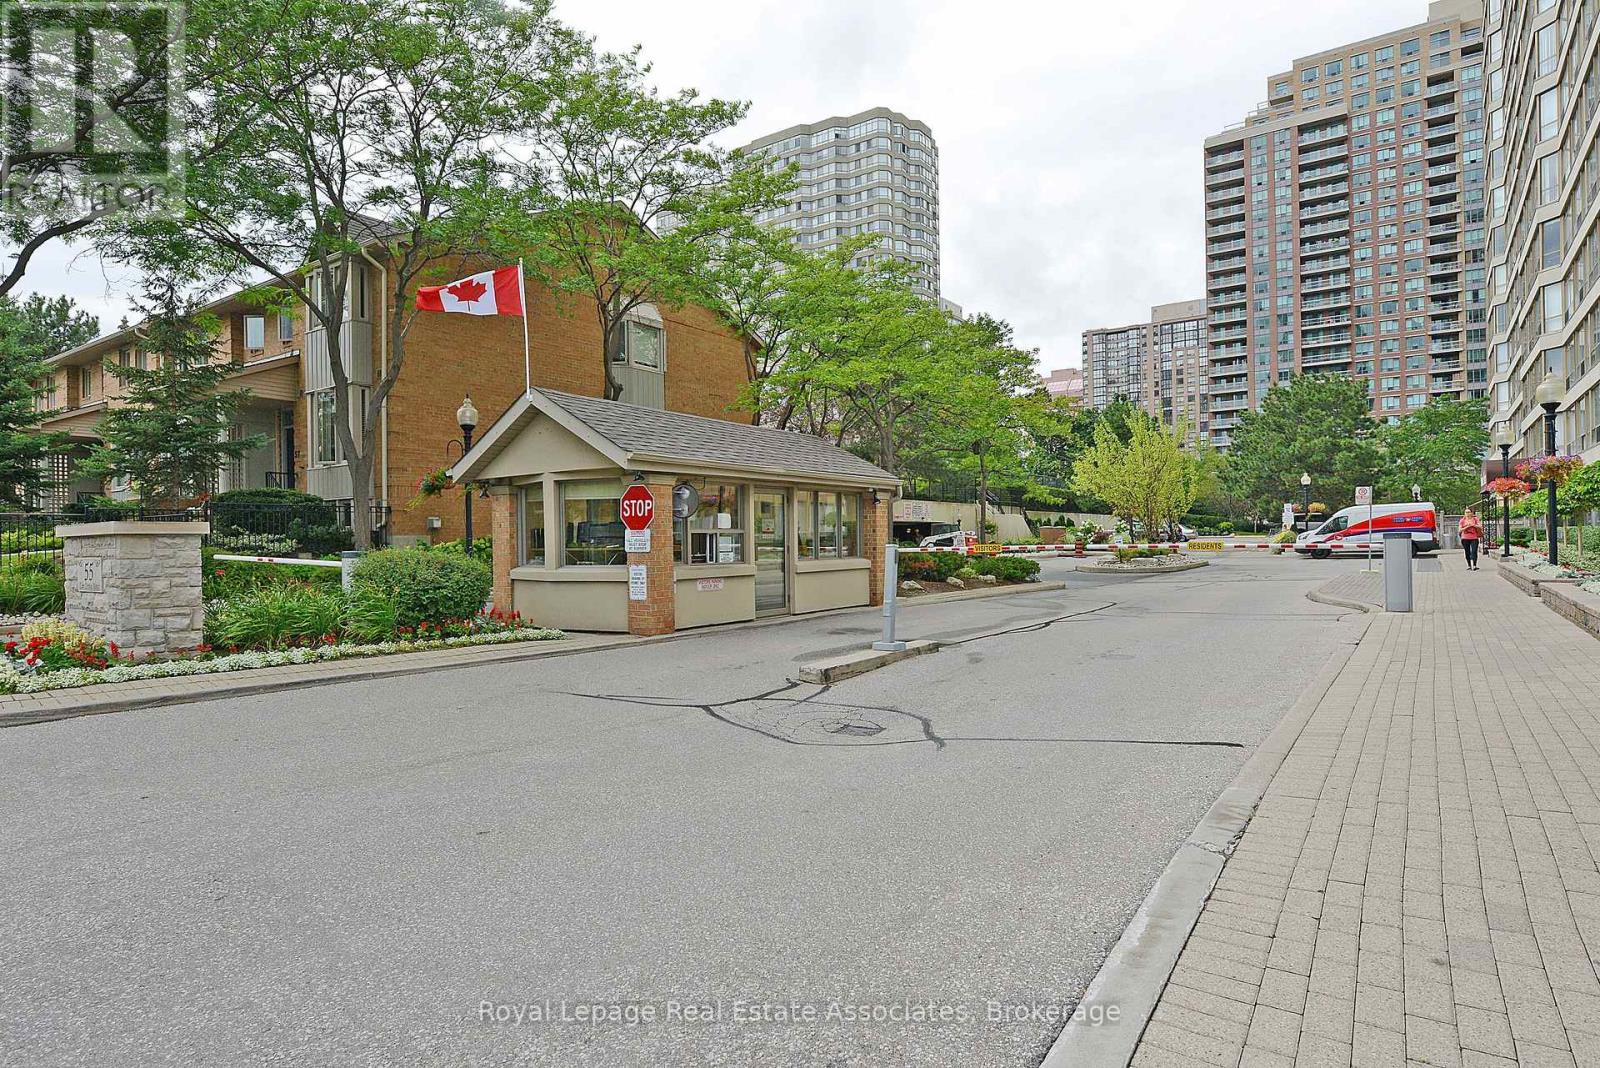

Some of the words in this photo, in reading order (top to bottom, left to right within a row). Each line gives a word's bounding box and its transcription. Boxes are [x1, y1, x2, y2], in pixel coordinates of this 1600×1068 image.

[623, 499, 652, 517] STOP
[974, 544, 1001, 552] VISITORS
[1188, 542, 1222, 550] RESIDENTS
[84, 562, 94, 580] 55
